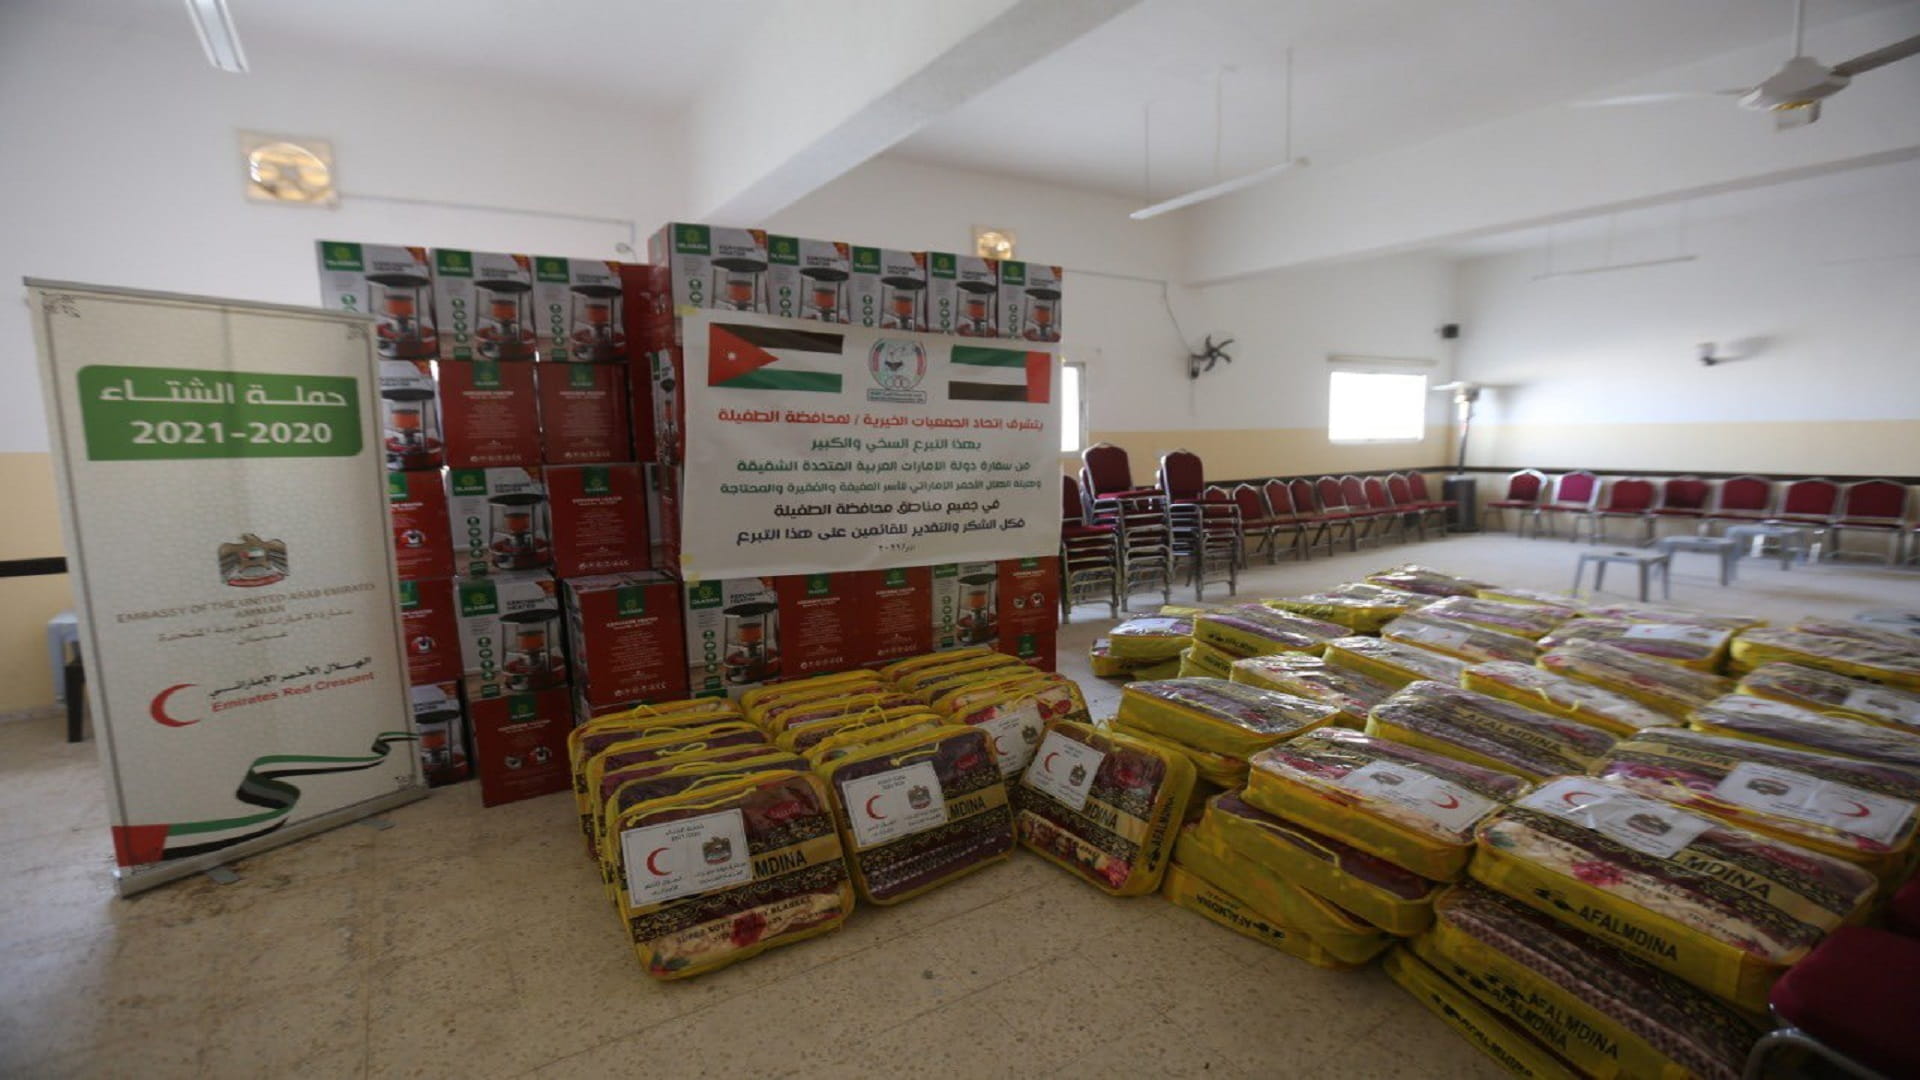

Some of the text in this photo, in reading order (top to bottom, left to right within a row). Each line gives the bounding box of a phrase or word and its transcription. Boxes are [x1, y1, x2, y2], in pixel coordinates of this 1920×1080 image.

[99, 377, 348, 407] حملة الشتاء
[718, 408, 780, 424] الطفيلة
[785, 410, 850, 424] لمحافظة
[863, 413, 908, 428] الخيرية
[912, 416, 969, 429] الجمعيات
[1006, 418, 1044, 431] يتشرف
[810, 437, 982, 453] بهذا التبرع السخي والكبير
[736, 459, 798, 474] الشقيقة
[802, 460, 852, 472] المتحدة
[856, 460, 898, 474] العربية
[950, 460, 977, 472] دولة
[980, 460, 1012, 472] سفارة
[1014, 461, 1031, 472] من
[719, 482, 784, 496] والمحتاجة
[787, 481, 836, 495] والفقيرة
[839, 481, 880, 493] العفيفة
[773, 498, 1001, 519] في جميع مناطق محافظة الطفيلة
[736, 517, 1026, 546] فكل الشكر والتقدير للقائمين على هذا التبرع
[117, 608, 185, 623] EMBASSY
[212, 671, 375, 712] Emirates Red Crescent
[948, 796, 986, 821] MDINA
[752, 850, 807, 880] MDINA
[1579, 905, 1678, 962] AFALMDINA
[1528, 993, 1618, 1060] AFALMDINA
